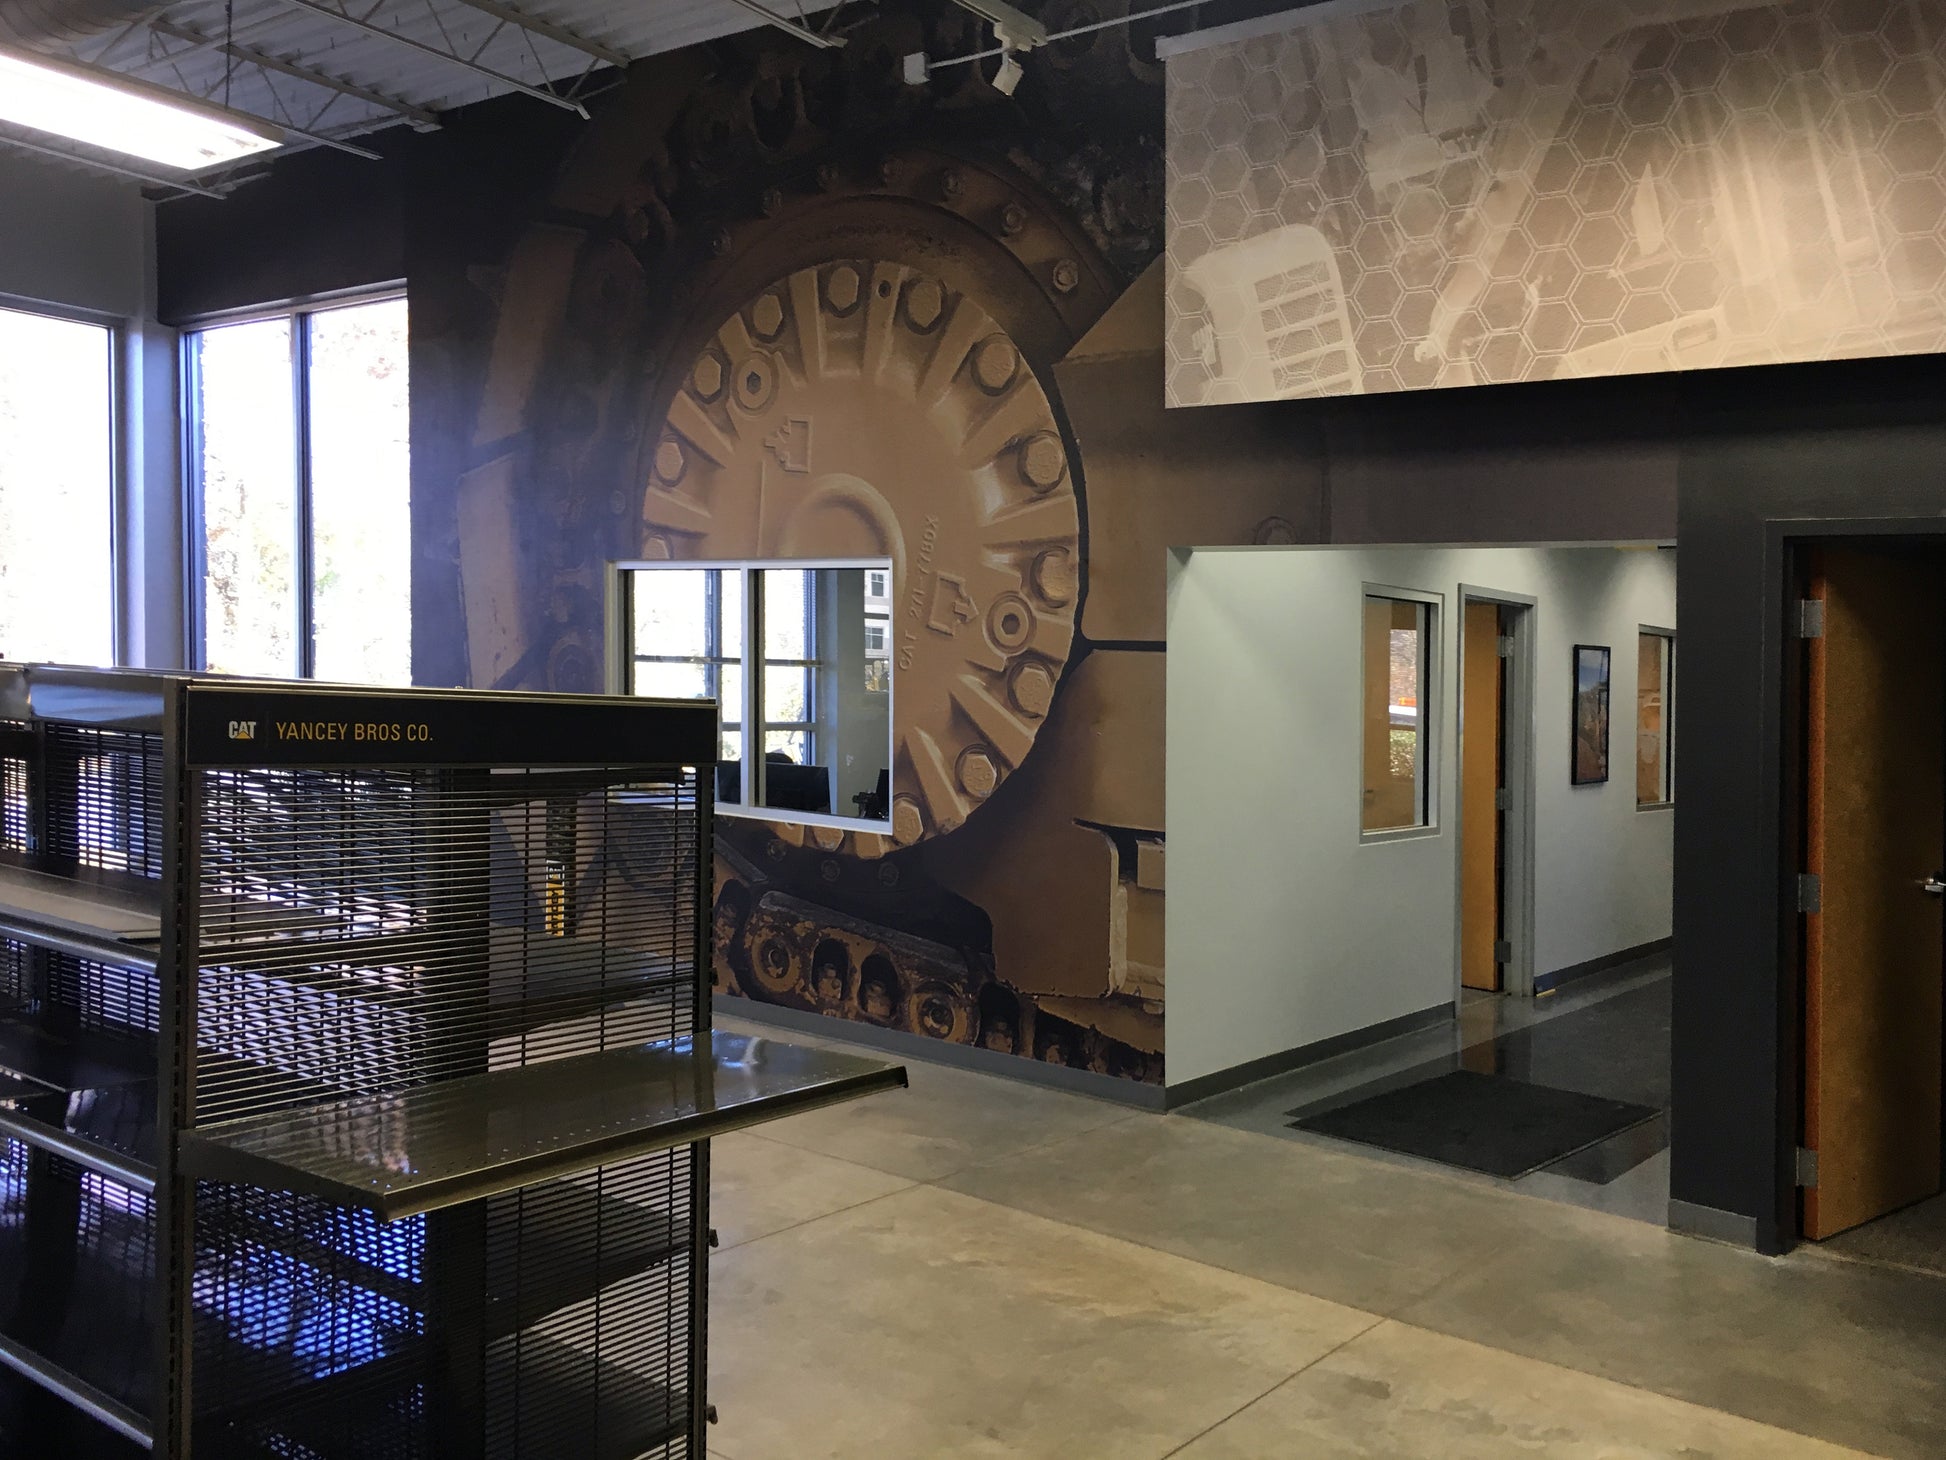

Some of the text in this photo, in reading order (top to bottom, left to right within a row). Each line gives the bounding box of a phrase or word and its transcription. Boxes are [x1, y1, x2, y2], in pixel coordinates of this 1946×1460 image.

[898, 630, 918, 671] CAT
[228, 720, 434, 741] CAT YANCEY BROS CO.
